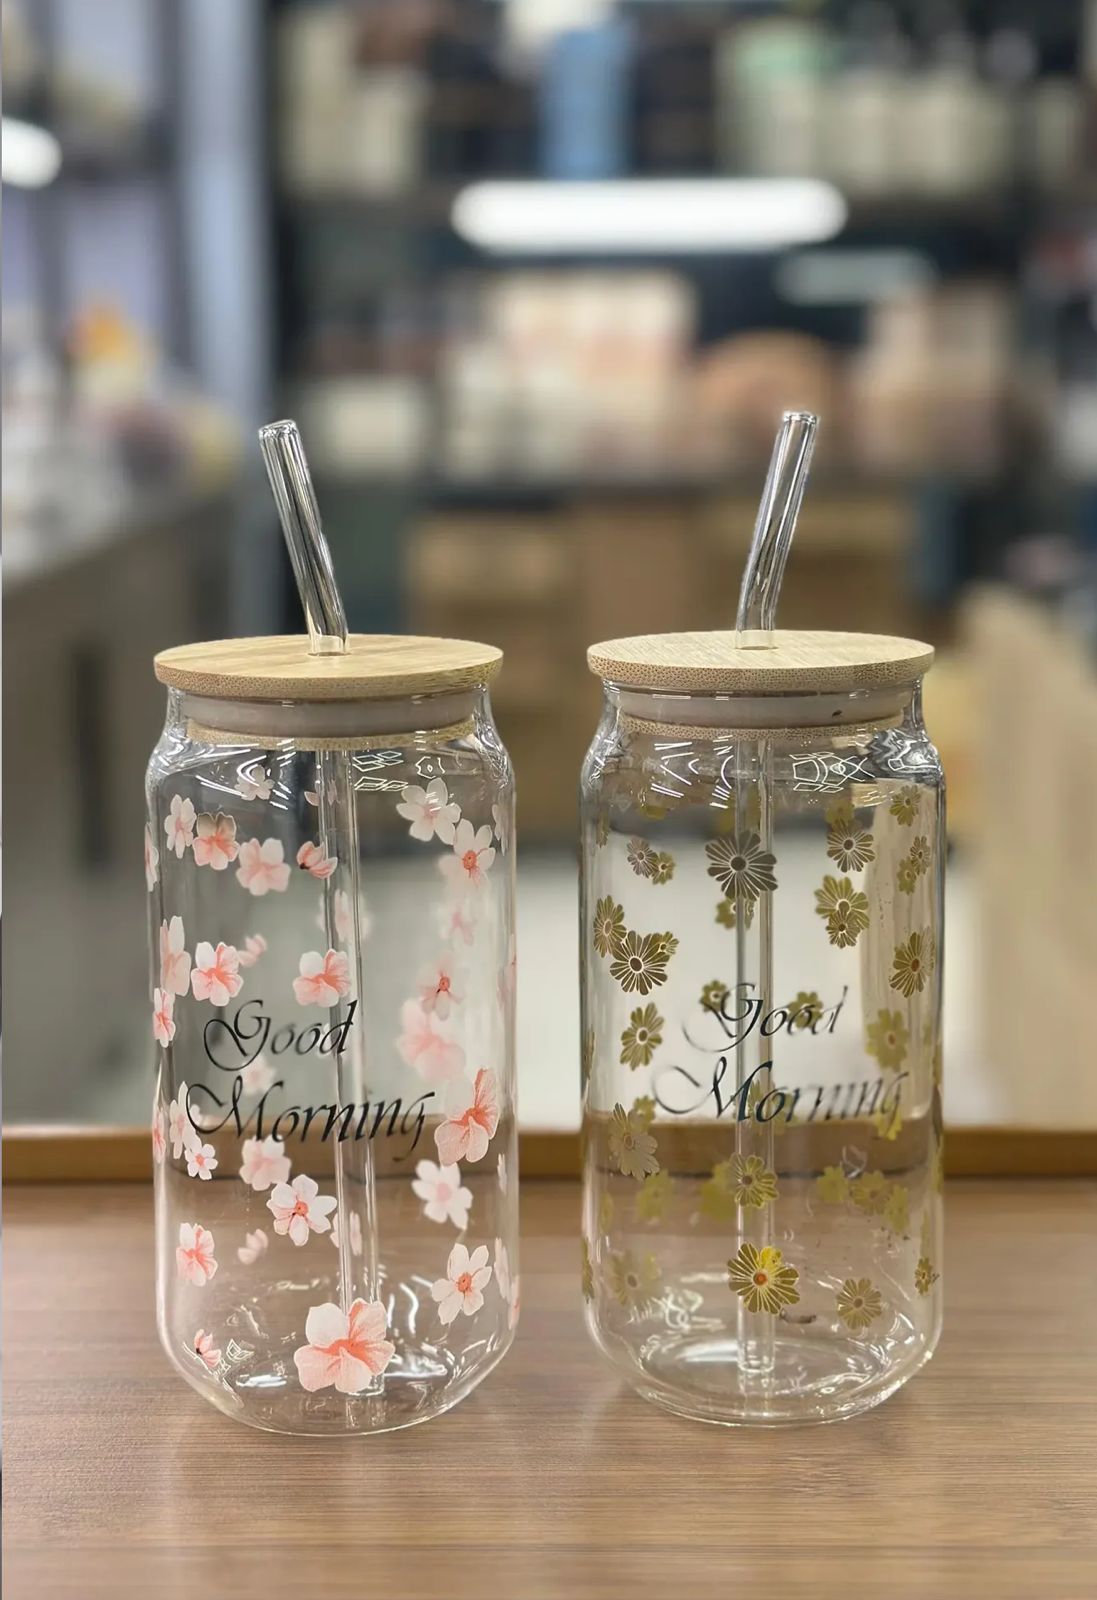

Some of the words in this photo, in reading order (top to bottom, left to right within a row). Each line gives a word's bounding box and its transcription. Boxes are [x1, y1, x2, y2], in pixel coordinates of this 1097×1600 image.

[203, 999, 358, 1071] Good
[682, 983, 848, 1052] Good
[185, 1075, 435, 1162] Morning
[652, 1056, 909, 1140] Morning
